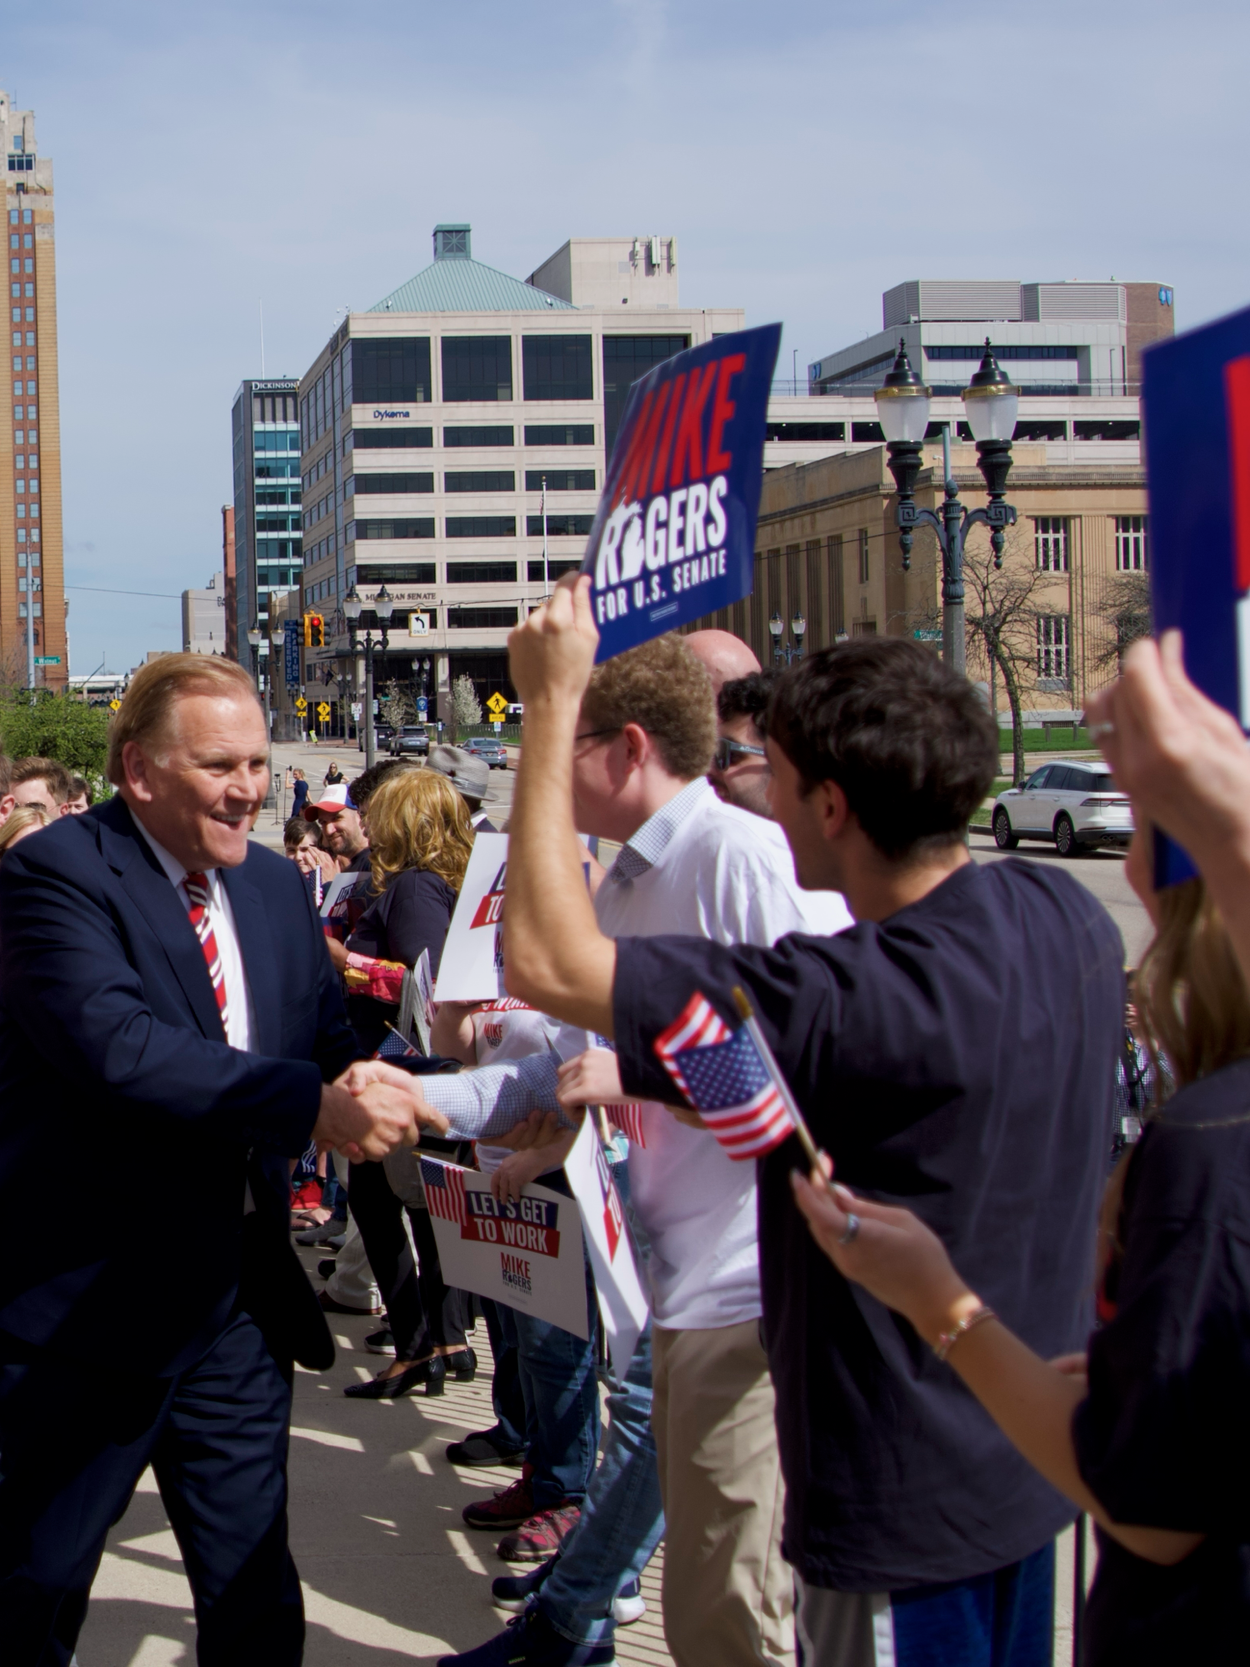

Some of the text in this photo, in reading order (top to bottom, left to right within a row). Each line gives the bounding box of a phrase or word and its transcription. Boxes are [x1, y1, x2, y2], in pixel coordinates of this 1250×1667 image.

[252, 381, 296, 391] DICKINSON
[373, 410, 410, 421] Dykema
[611, 353, 746, 511] MIKE
[595, 475, 728, 590] ROGERS
[406, 592, 437, 600] SENATE
[597, 549, 727, 624] FOR U.S. SENATE
[470, 1192, 548, 1226] LETS GET
[473, 1218, 548, 1253] TO WORK
[500, 1251, 532, 1280] MIKE
